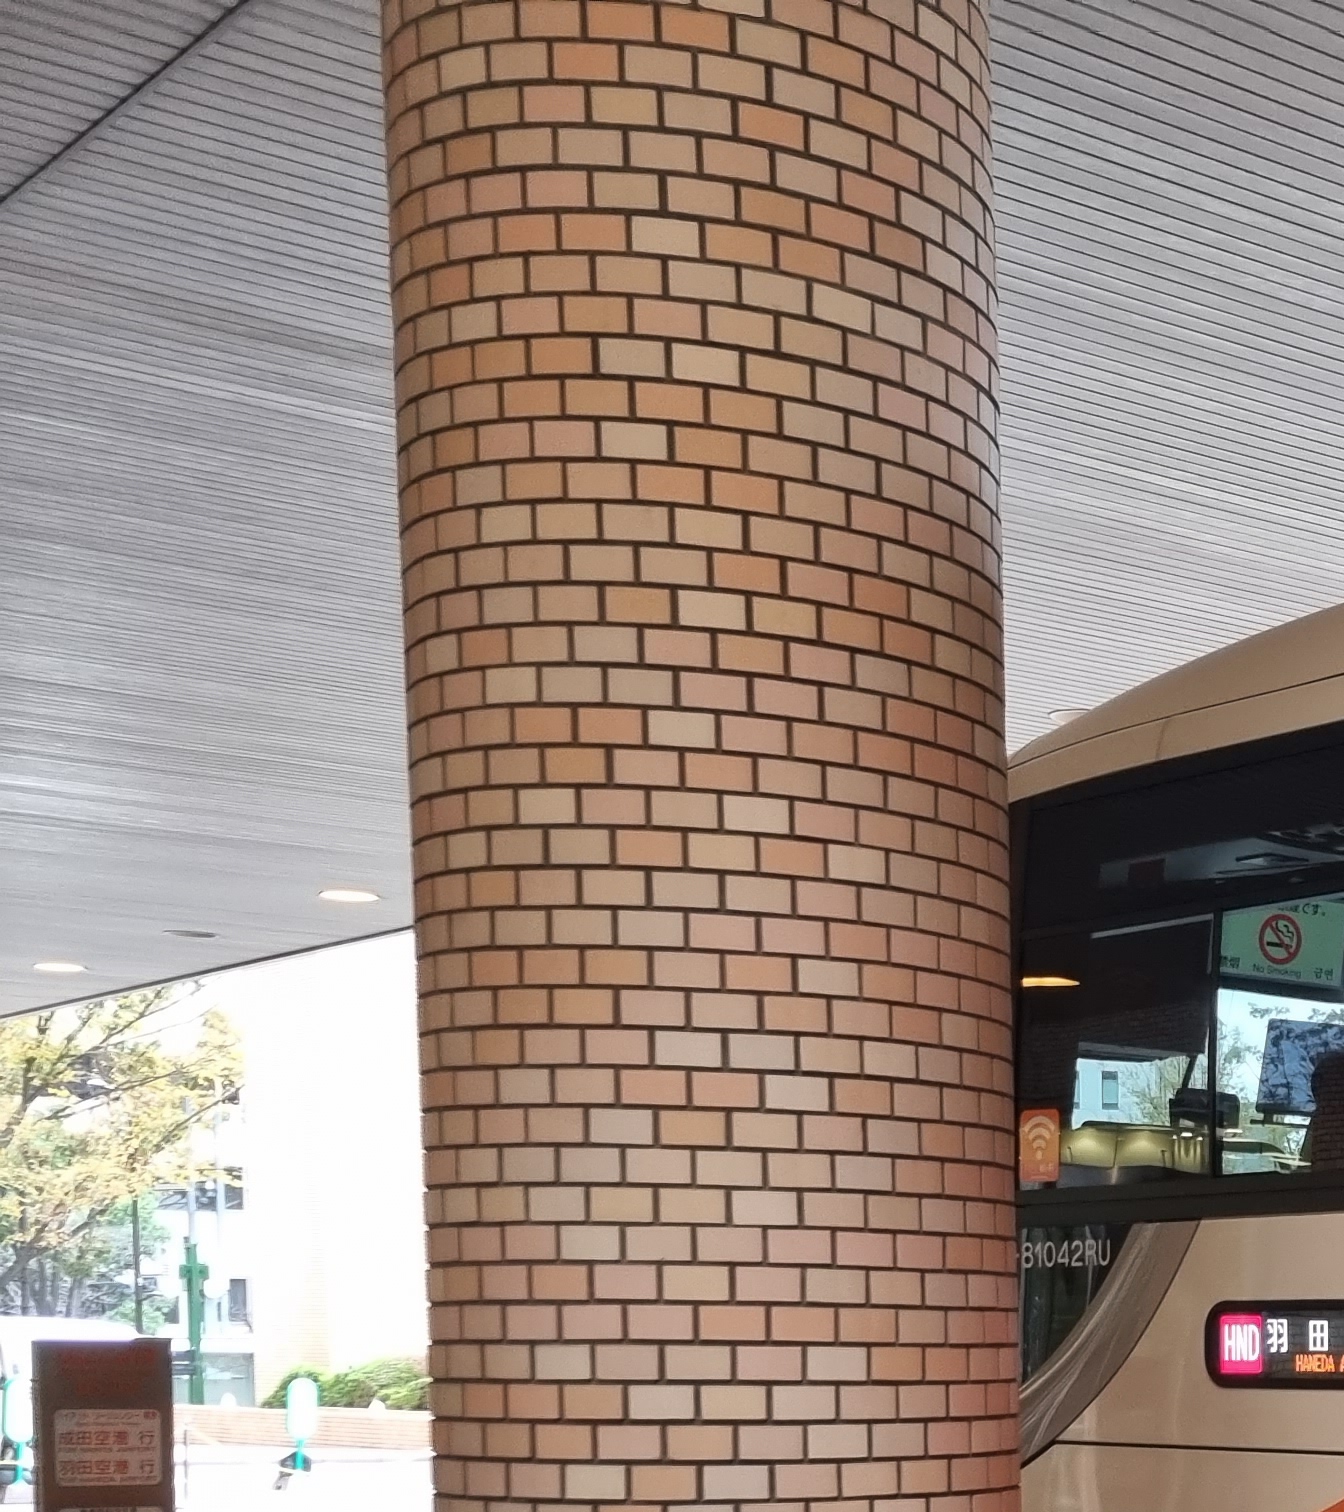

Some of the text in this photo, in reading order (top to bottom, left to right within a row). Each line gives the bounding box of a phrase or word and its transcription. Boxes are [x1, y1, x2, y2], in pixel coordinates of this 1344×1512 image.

[1252, 963, 1302, 979] No Smoking
[1223, 1323, 1260, 1362] HND
[1295, 1354, 1335, 1373] HANEDA
